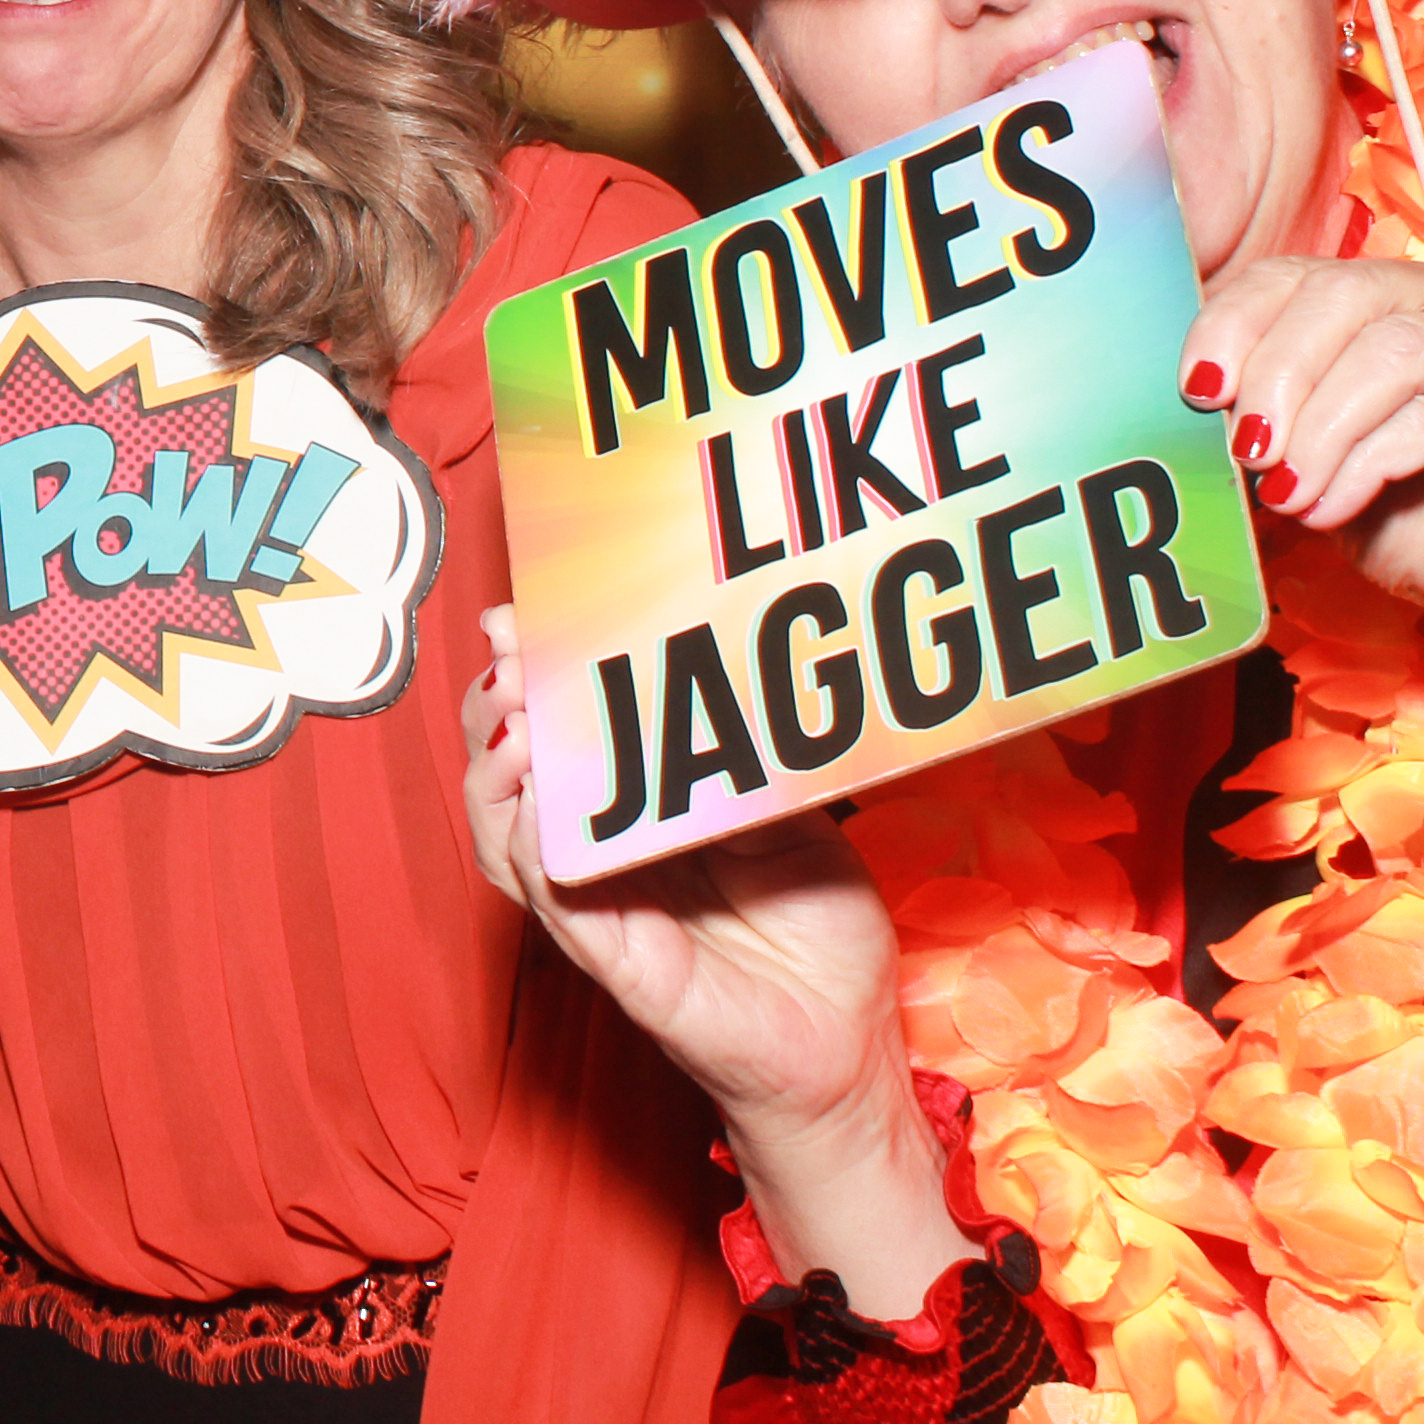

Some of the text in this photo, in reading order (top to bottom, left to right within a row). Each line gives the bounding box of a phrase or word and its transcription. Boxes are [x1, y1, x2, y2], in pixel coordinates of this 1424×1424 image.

[561, 98, 1096, 458] MOVES
[696, 332, 1011, 585] LIKE
[580, 457, 1207, 845] JAGGER
